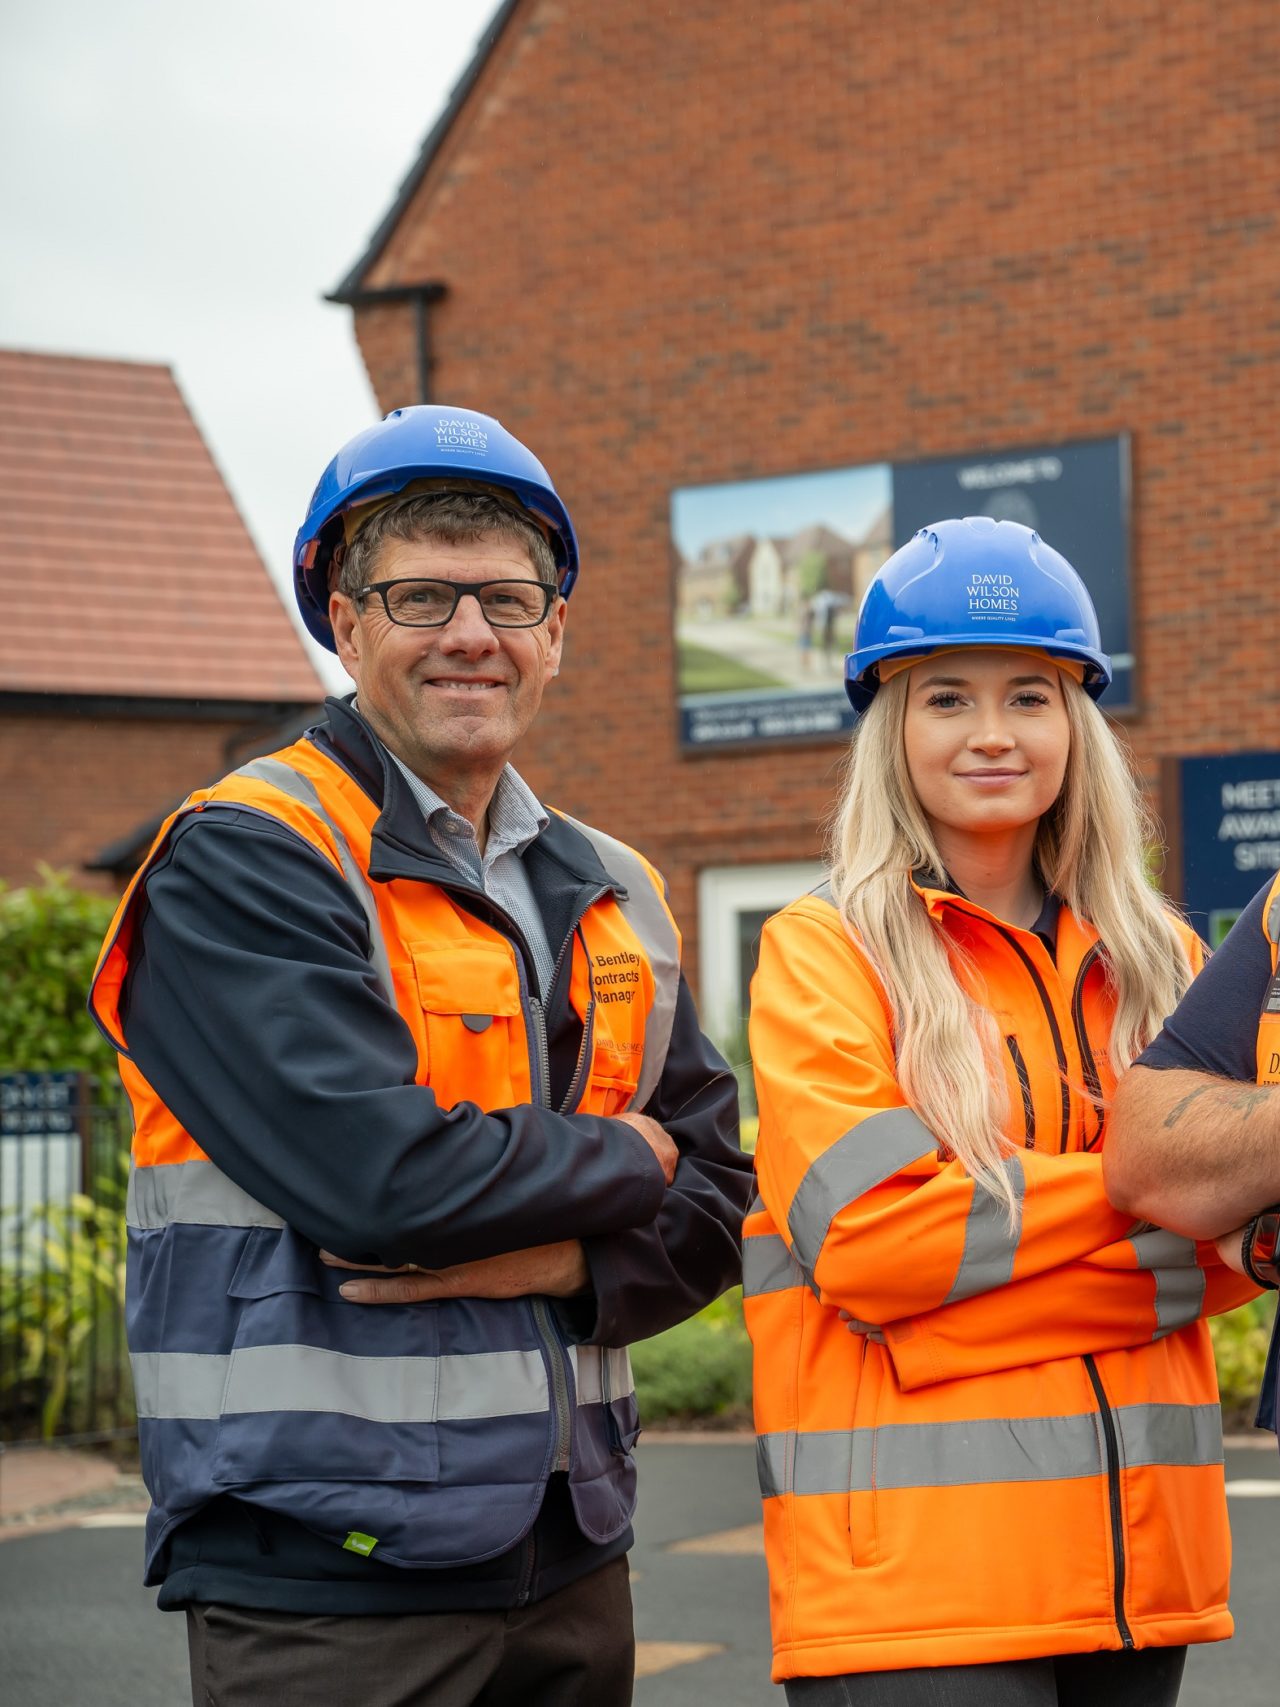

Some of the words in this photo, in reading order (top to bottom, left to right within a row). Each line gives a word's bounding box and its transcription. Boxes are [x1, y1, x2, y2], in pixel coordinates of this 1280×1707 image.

[439, 419, 480, 430] DAVID
[433, 427, 488, 440] WILSON
[437, 435, 487, 448] HOMES
[972, 574, 1013, 585] DAVID
[967, 585, 1020, 598] WILSON
[969, 598, 1018, 611] HOMES
[596, 952, 640, 967] Bentley
[593, 970, 639, 986] ontracts
